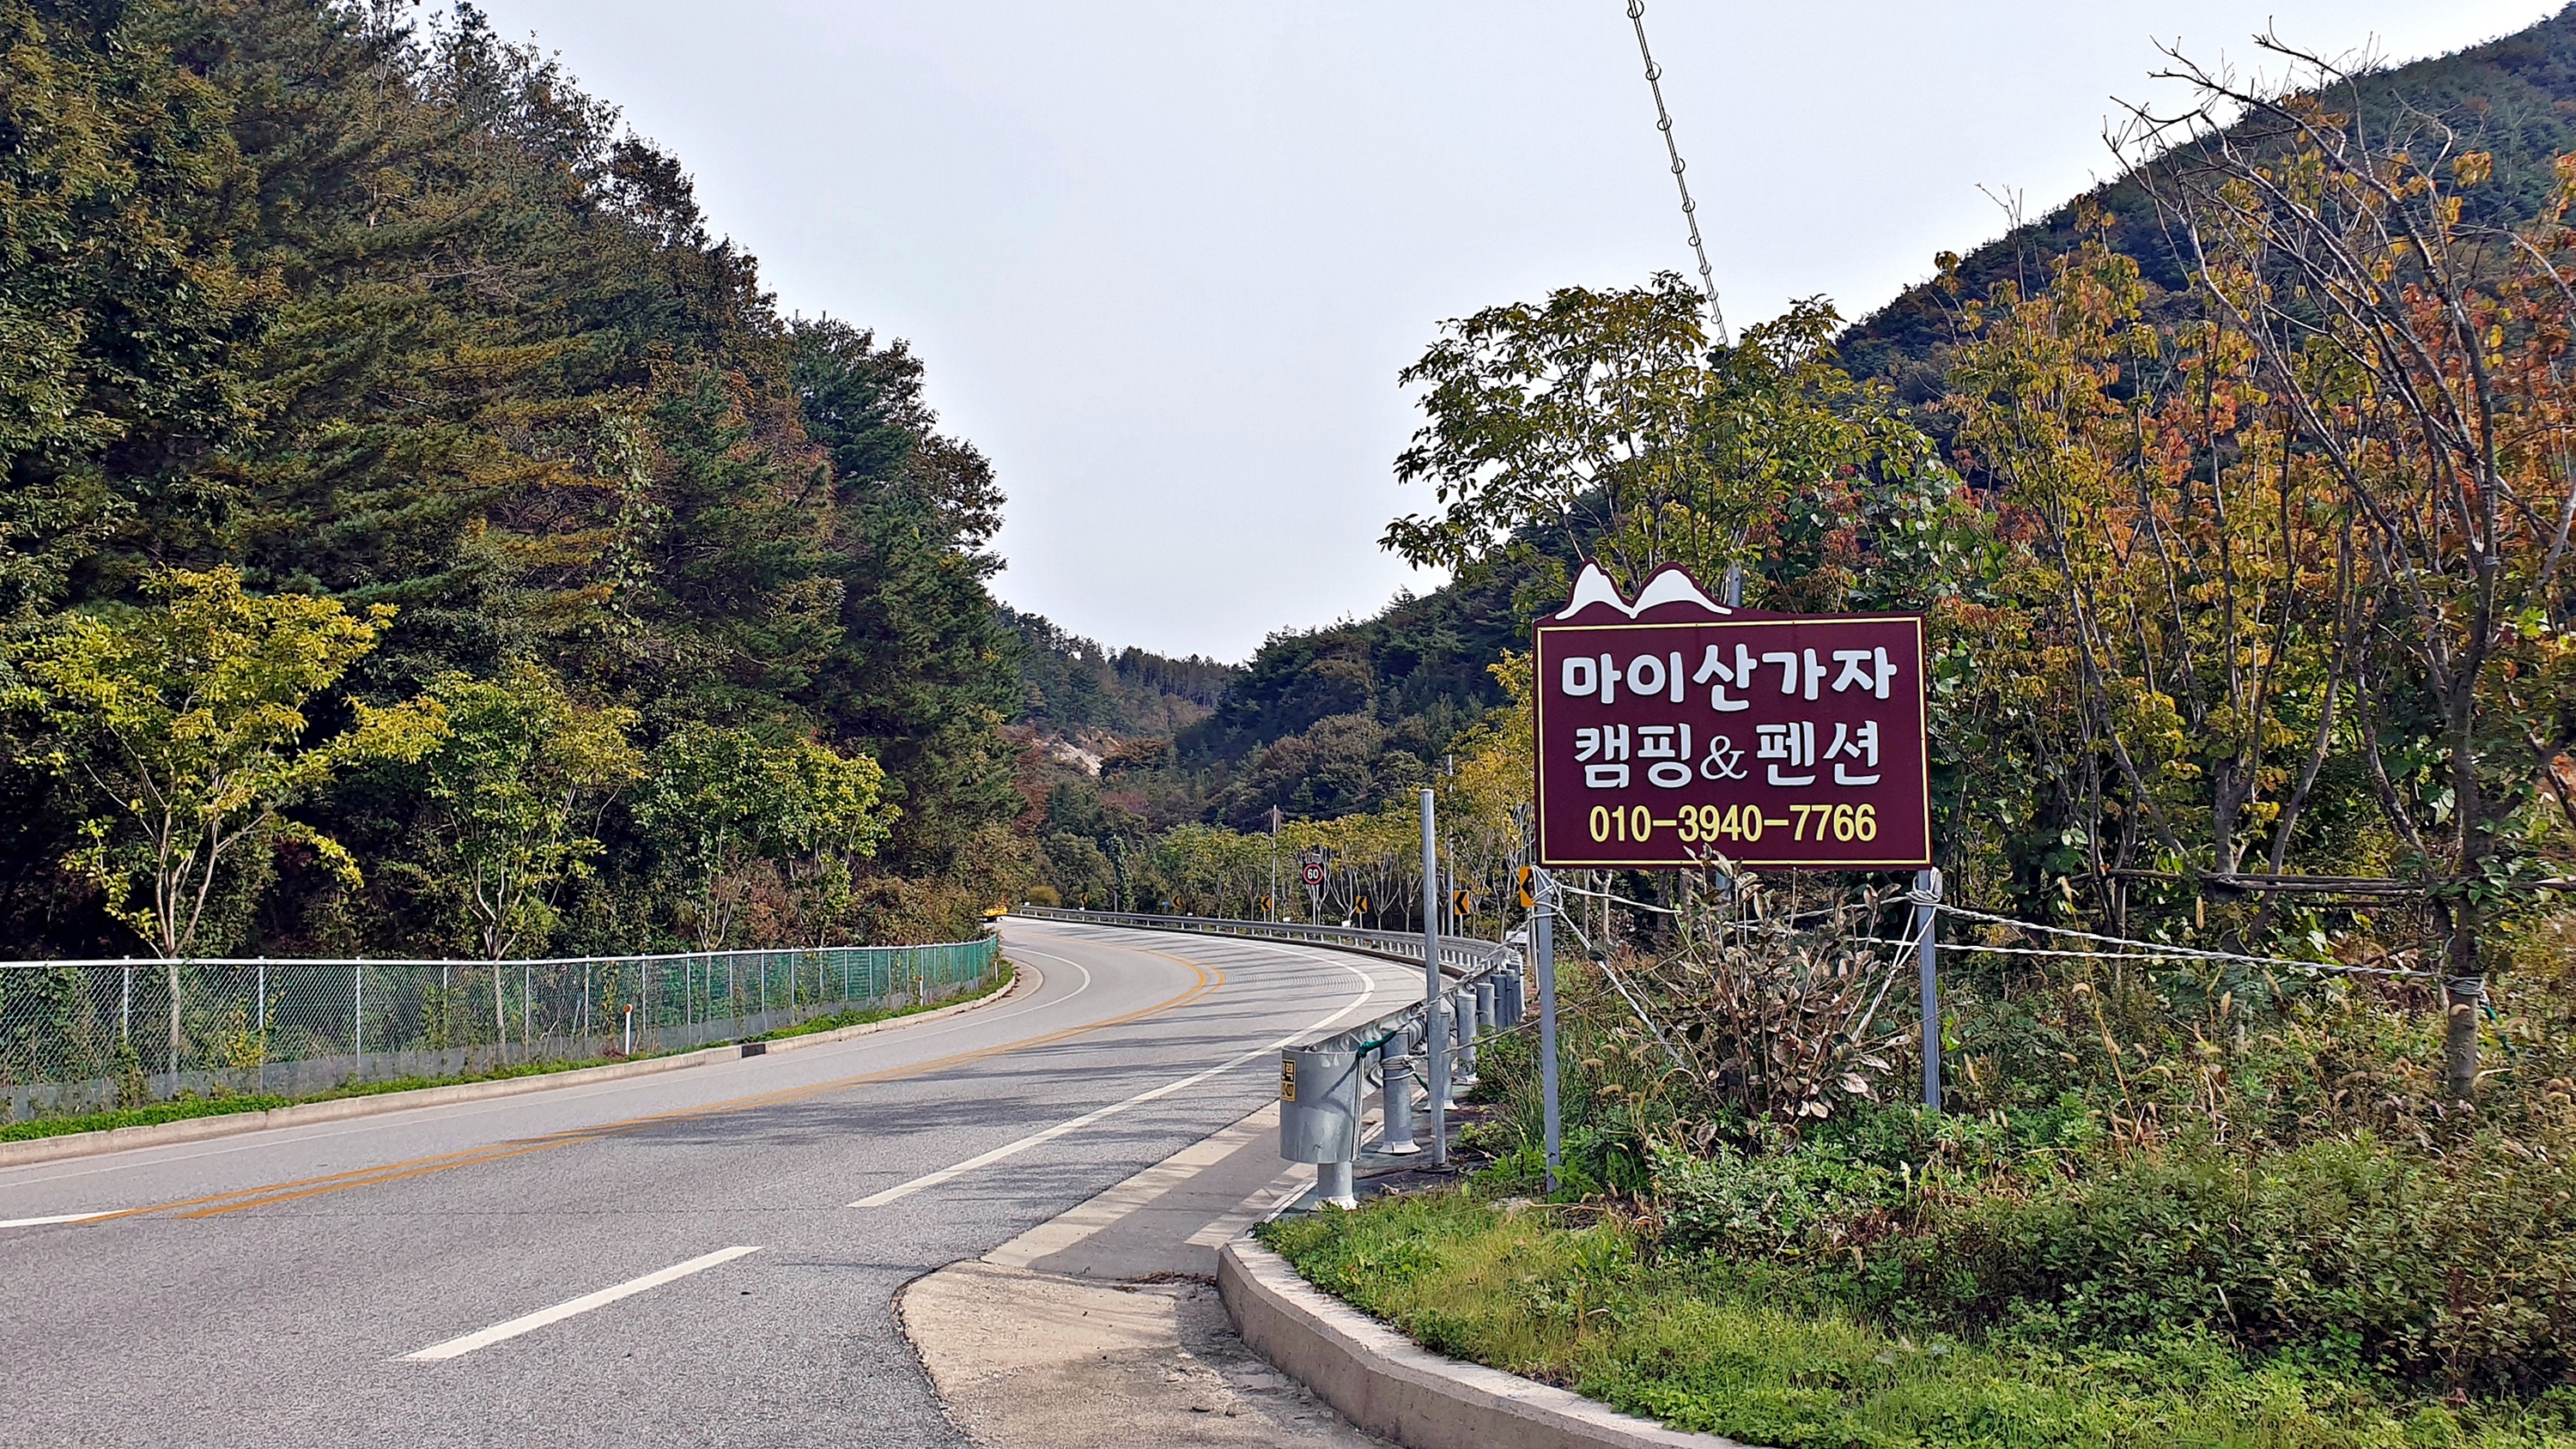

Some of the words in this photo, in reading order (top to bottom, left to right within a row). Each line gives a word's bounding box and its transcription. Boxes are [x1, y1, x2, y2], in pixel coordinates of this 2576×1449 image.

[1562, 643, 1898, 712] 마이산가자
[1589, 803, 1877, 842] 010-3940-7766
[1307, 868, 1319, 879] 60
